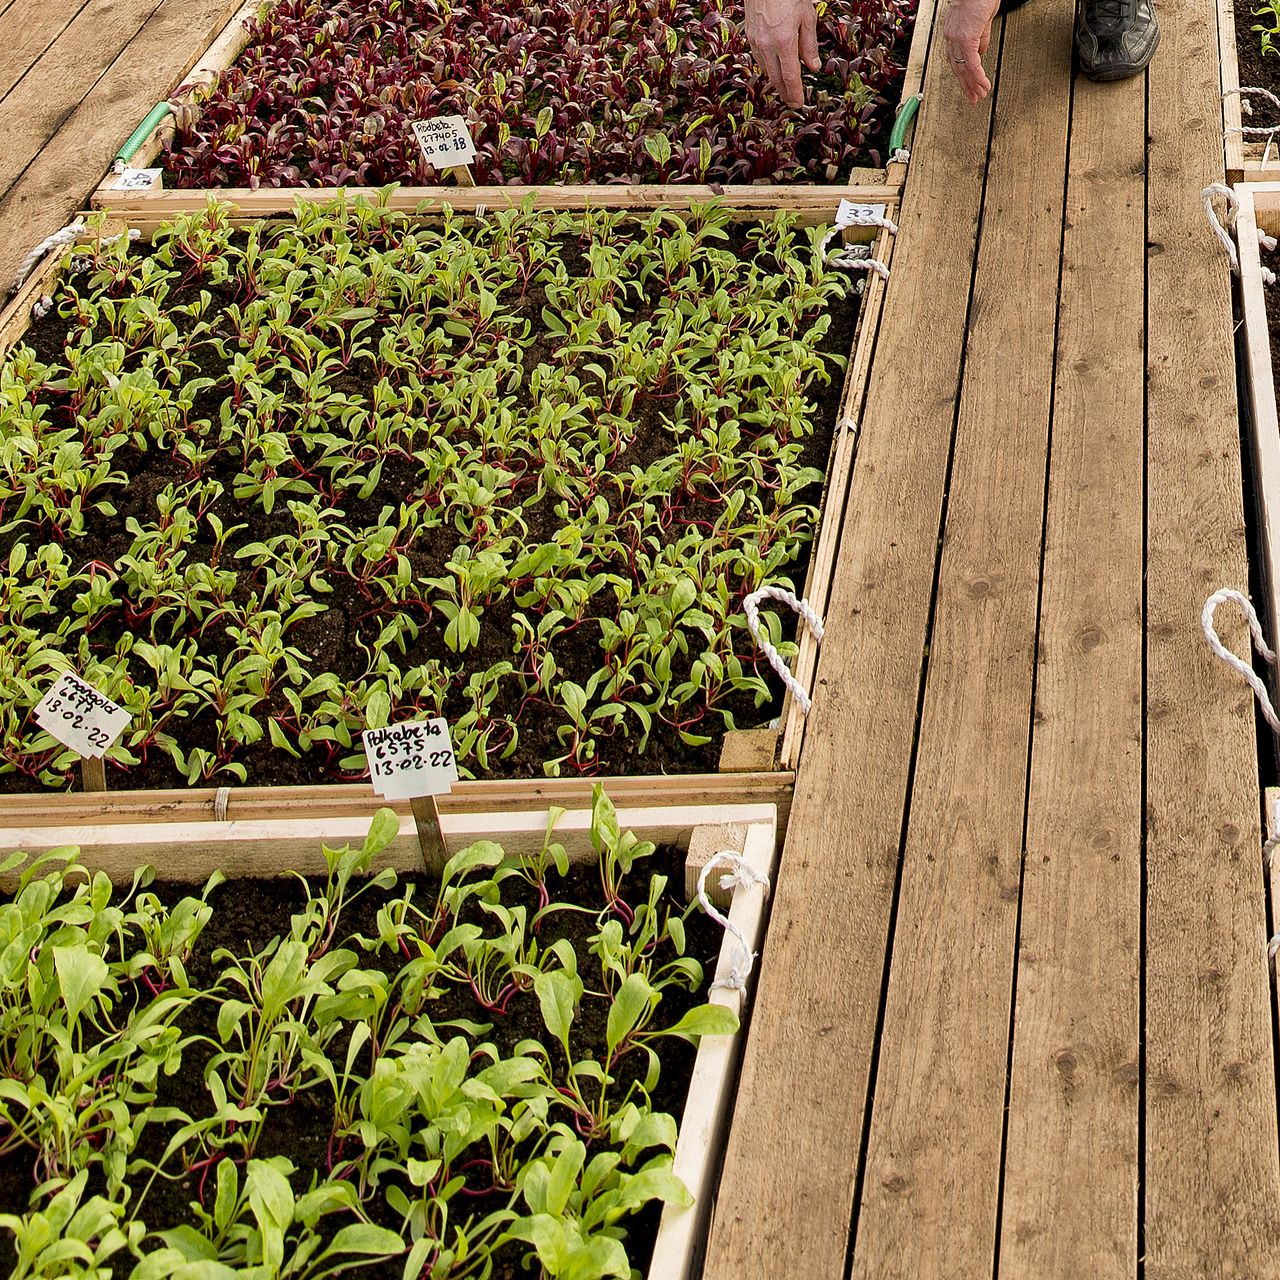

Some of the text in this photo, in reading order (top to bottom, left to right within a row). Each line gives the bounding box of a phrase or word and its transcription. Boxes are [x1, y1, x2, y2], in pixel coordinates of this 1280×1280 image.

[422, 129, 458, 144] 277405
[64, 675, 119, 715] mangold
[367, 720, 442, 748] Polkabeta
[376, 739, 425, 760] 6575
